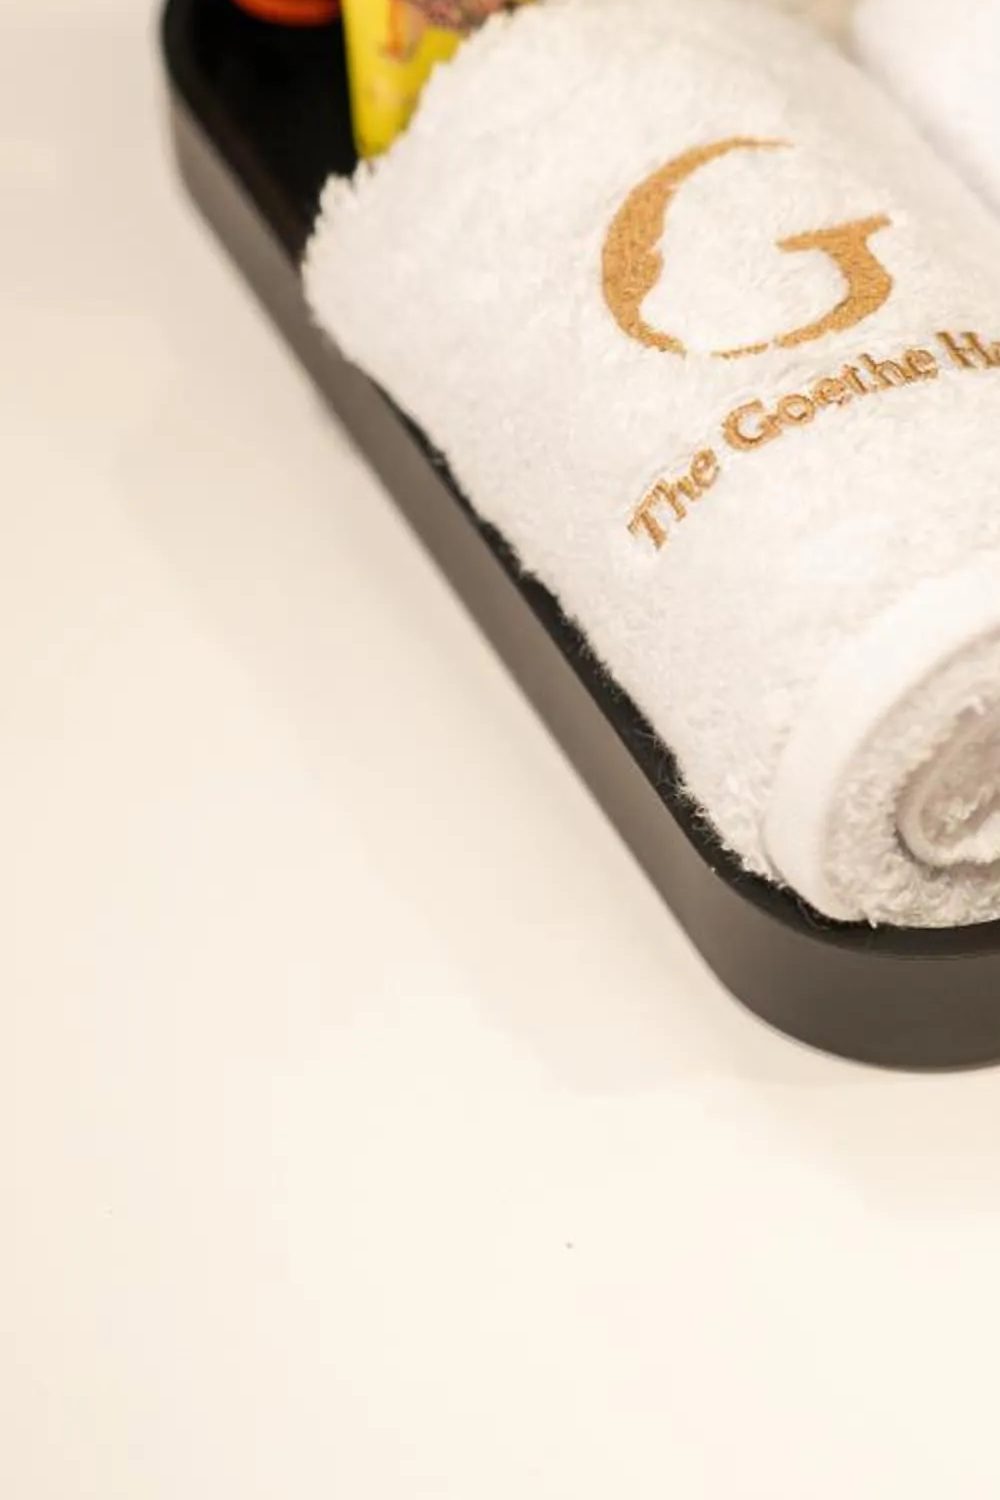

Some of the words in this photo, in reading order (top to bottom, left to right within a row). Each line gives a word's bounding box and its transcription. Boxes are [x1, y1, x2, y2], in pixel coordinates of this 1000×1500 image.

[601, 135, 894, 361] G
[626, 447, 721, 550] The
[722, 346, 940, 452] Goethe
